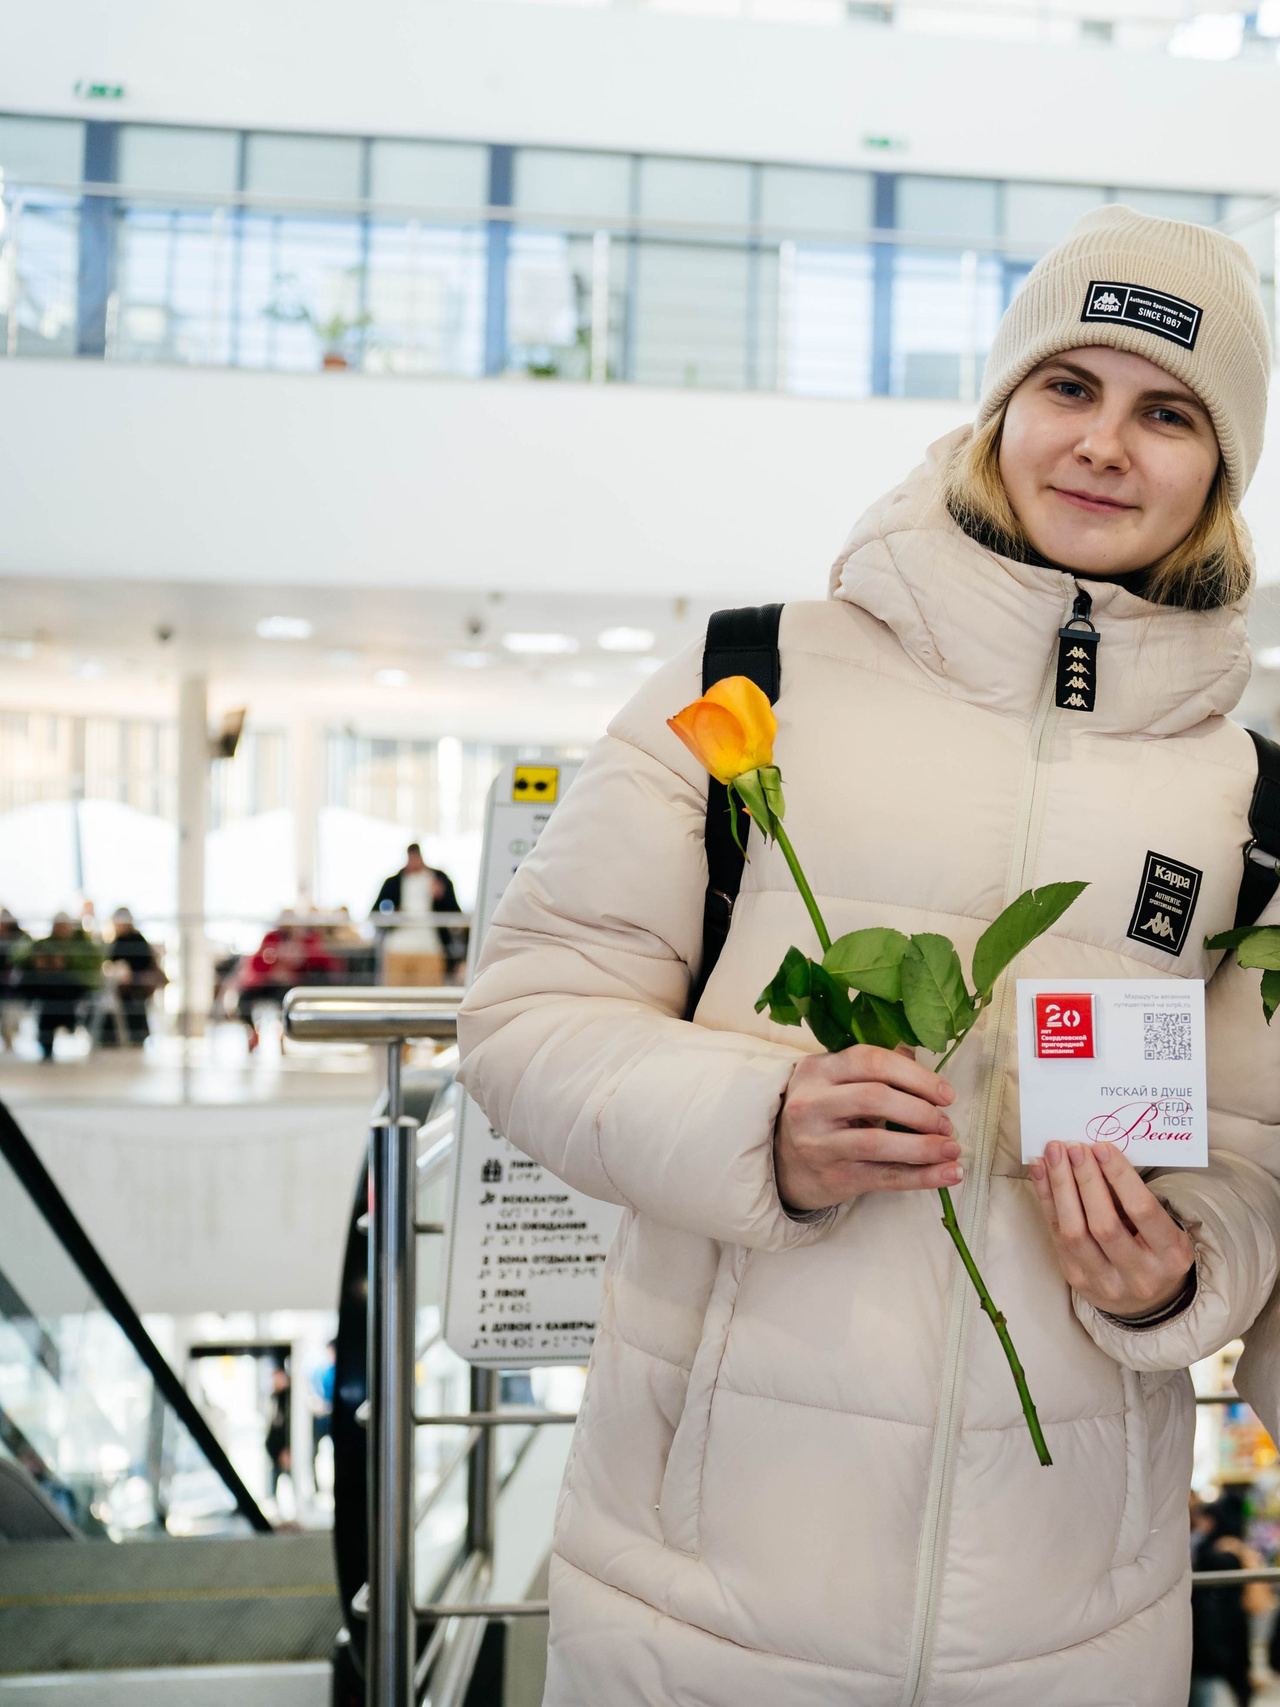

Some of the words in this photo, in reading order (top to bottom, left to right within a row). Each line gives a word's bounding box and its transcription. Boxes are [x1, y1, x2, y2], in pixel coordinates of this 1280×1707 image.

[1093, 301, 1119, 313] Kappa
[1129, 296, 1152, 306] Authentic
[1179, 311, 1193, 323] Brand
[1138, 307, 1161, 321] SINCE
[1162, 315, 1181, 329] 1967
[1154, 864, 1191, 889] Kappa
[1155, 891, 1181, 906] AUTHENTIC
[1045, 1004, 1081, 1027] 20
[1100, 1085, 1148, 1096] ПУСКАЙ
[1151, 1087, 1158, 1096] В
[1160, 1087, 1192, 1098] ДУШЕ
[1150, 1101, 1194, 1112] ВСЕГДА
[1163, 1116, 1194, 1126] ПОЕТ
